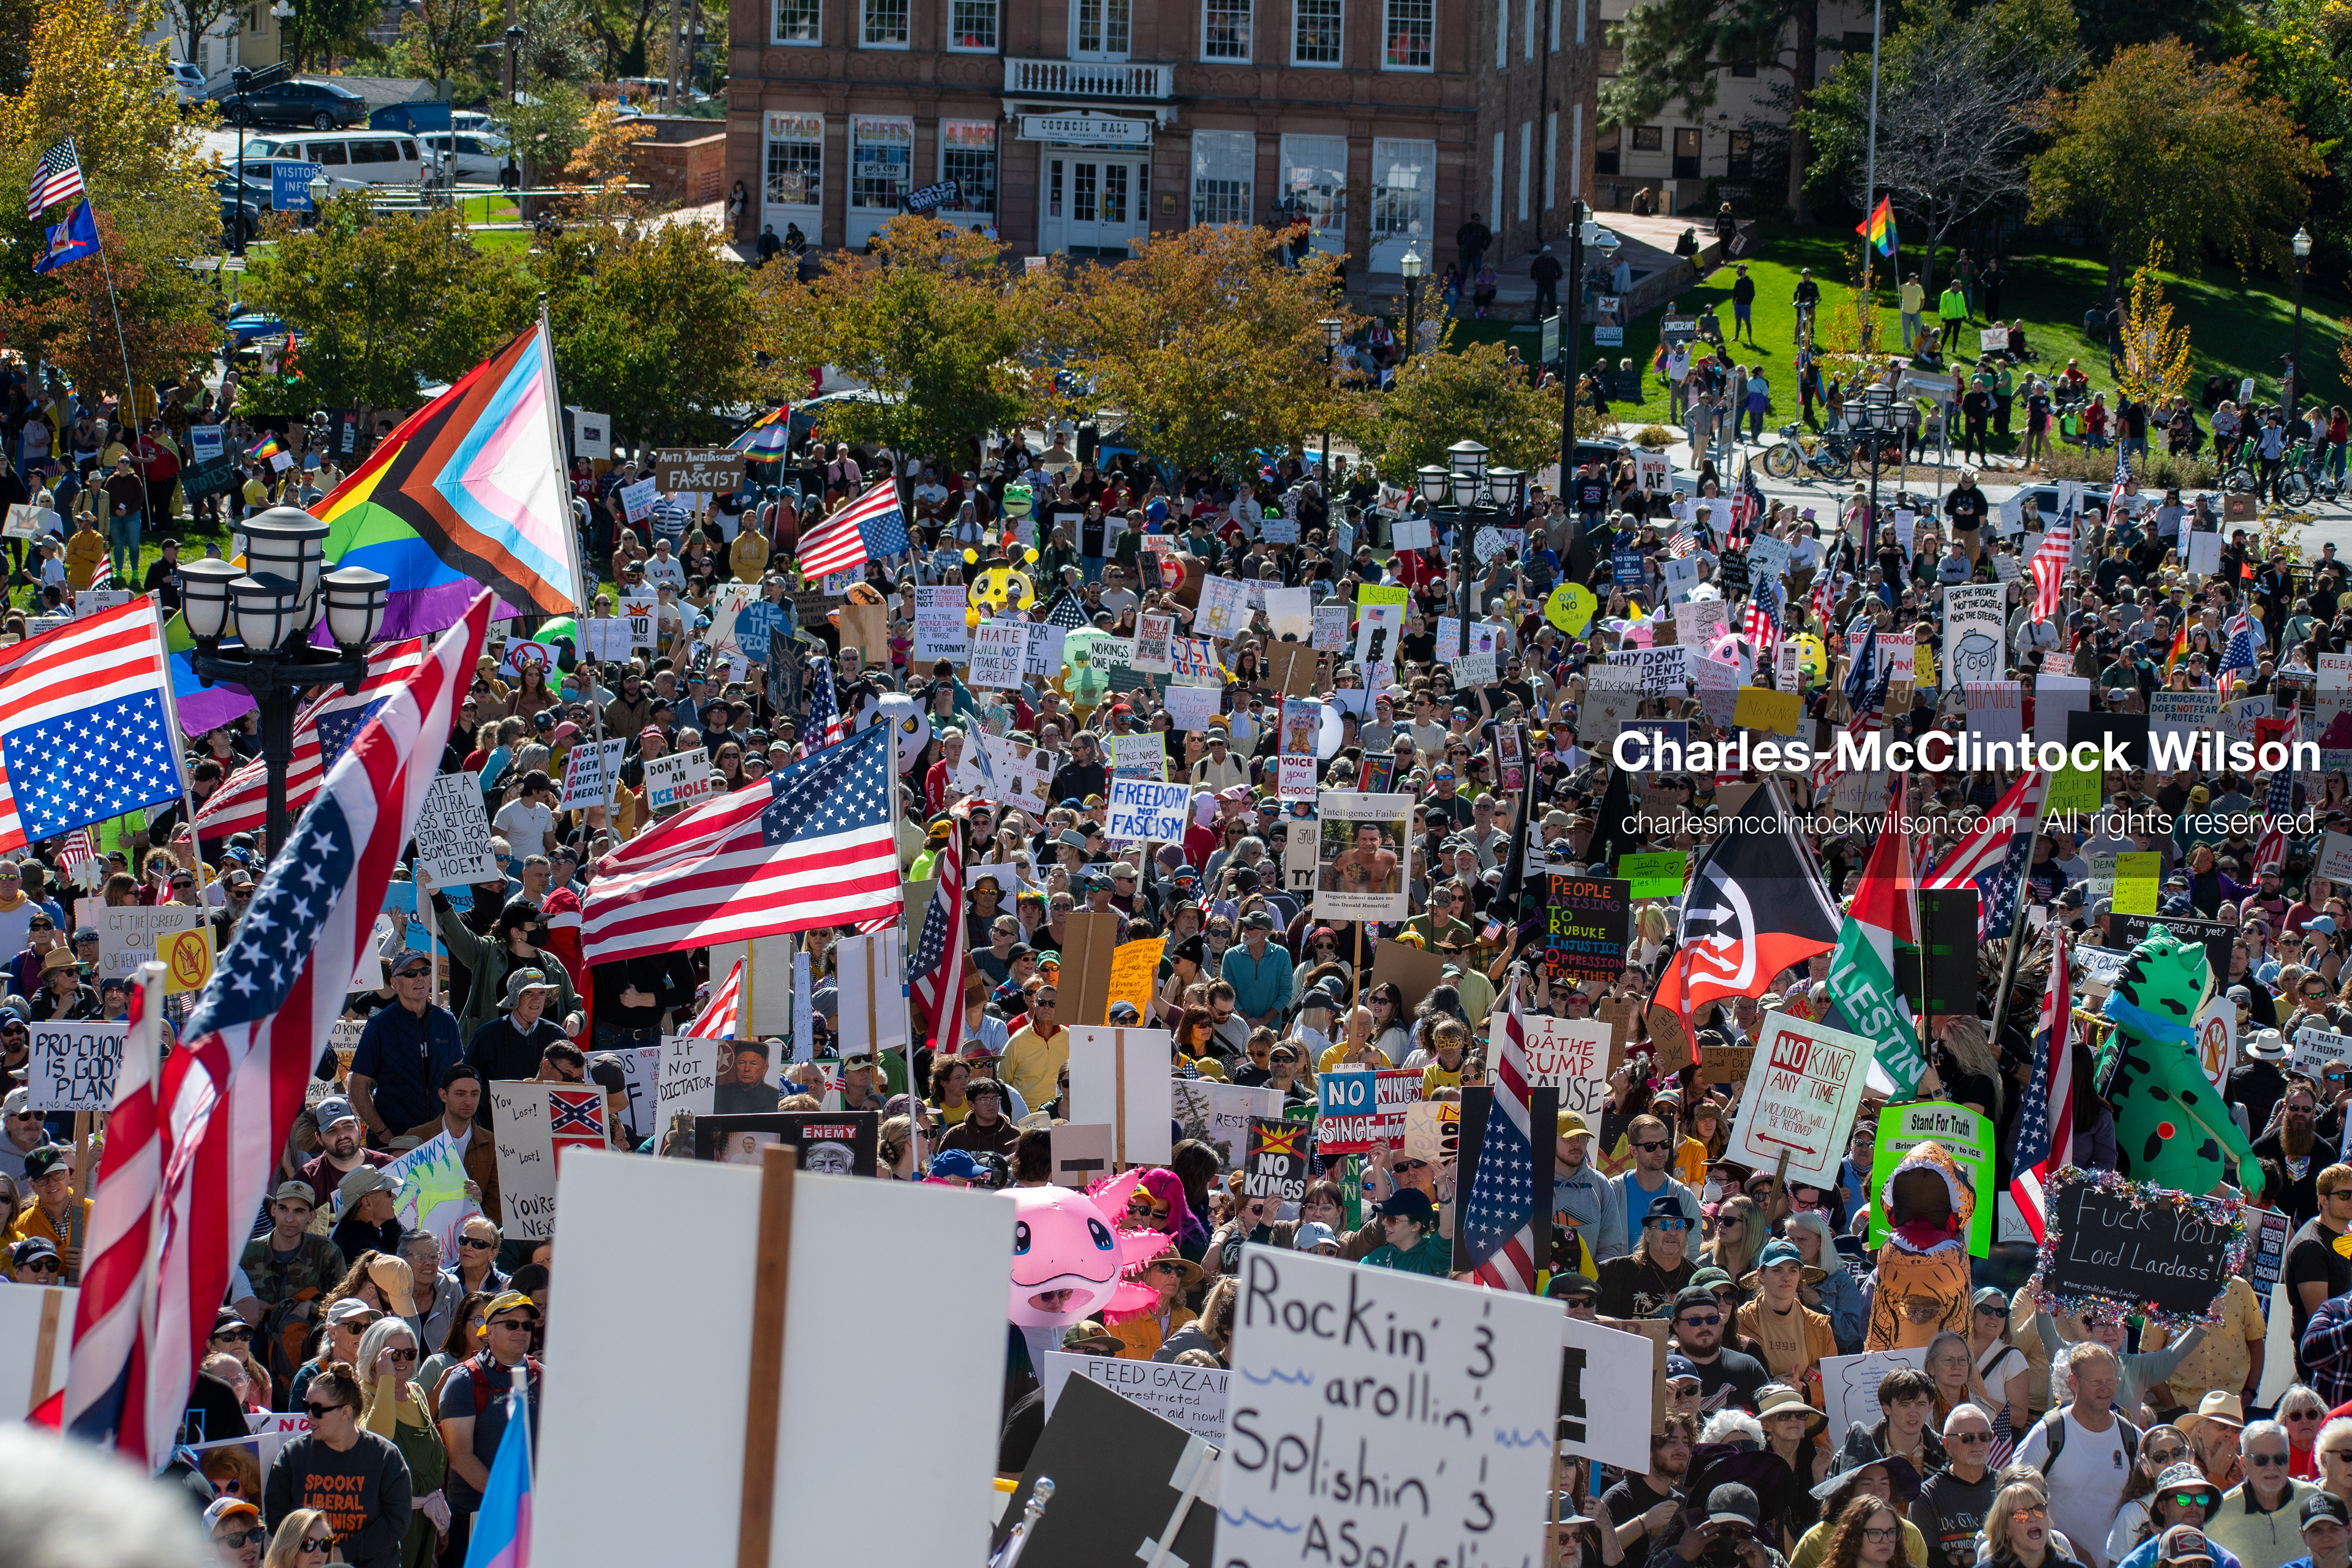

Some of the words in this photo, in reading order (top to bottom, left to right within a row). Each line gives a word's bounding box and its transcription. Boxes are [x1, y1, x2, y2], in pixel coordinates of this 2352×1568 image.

[771, 119, 820, 137] UTAH
[858, 123, 910, 141] GIFTS
[962, 126, 995, 146] INFO
[1042, 121, 1090, 132] COUNCIL
[1102, 123, 1128, 133] HALL
[276, 167, 318, 178] VISITOR
[285, 182, 309, 192] INFO
[659, 451, 682, 462] ANTI
[1645, 472, 1665, 489] AF
[1949, 591, 1961, 602] FOR
[1961, 589, 1973, 598] THE
[1975, 588, 1998, 598] PEOPLE
[1954, 601, 1967, 611] NOT
[1967, 600, 1979, 609] THE
[1980, 599, 2003, 611] CASTLE
[1142, 618, 1162, 630] ONLY
[1163, 621, 1168, 632] A
[1950, 612, 1964, 622] NOR
[1977, 611, 2002, 626] STEEPLE
[981, 630, 1020, 643] HATE
[1142, 630, 1167, 641] FASCIST
[926, 644, 966, 653] TYRANNY
[974, 645, 998, 655] WILL
[1001, 646, 1022, 657] NOT
[974, 657, 1000, 668] MAKE
[1593, 666, 1618, 677] WHAT
[1624, 667, 1632, 677] A
[978, 671, 1014, 684] GREAT
[1587, 678, 1643, 697] FAUX-KING
[1967, 682, 2016, 710] ORANGE
[1589, 694, 1629, 707] NIGHTMARE
[2156, 693, 2215, 705] DEMOCRACY
[2176, 704, 2193, 713] NOT
[2165, 714, 2206, 725] PROTEST,
[650, 757, 682, 776] DON'T
[692, 752, 705, 765] BE
[1282, 757, 1313, 767] VOICE
[672, 771, 686, 783] AN
[1285, 771, 1311, 784] your
[652, 778, 709, 805] ICEHOLE
[1114, 782, 1188, 810] FREEDOM
[1280, 786, 1316, 794] CHOICE
[444, 805, 488, 828] BITCH!
[1324, 807, 1373, 819] Intelligence
[1375, 809, 1406, 818] Failure
[418, 829, 457, 846] STAND
[462, 824, 489, 841] FOR
[1111, 813, 1183, 842] FASCISM
[422, 840, 494, 861] SOMETHING
[438, 856, 484, 878] HOE!!
[1551, 875, 1611, 899] PEOPLE
[1547, 894, 1621, 912] ARISING
[1547, 906, 1573, 922] TO
[1550, 919, 1606, 939] RUBUKE
[1545, 934, 1619, 954] INJUSTICE
[1546, 949, 1624, 968] OPPRESSION
[1546, 963, 1616, 983] TOGETHER
[672, 1039, 693, 1056] IF
[2317, 1033, 2344, 1045] HATE
[1774, 1035, 1804, 1069] NO
[1809, 1042, 1850, 1081] KING
[2310, 1044, 2345, 1057] TRUMP
[45, 1058, 64, 1079] IS
[669, 1060, 701, 1076] NOT
[2304, 1055, 2321, 1066] FOR
[54, 1077, 116, 1102] PLAN
[660, 1076, 714, 1101] DICTATOR
[1329, 1080, 1365, 1106] NO
[1374, 1077, 1423, 1104] KINGS
[1770, 1071, 1801, 1093] ANY
[1811, 1080, 1839, 1104] TIME
[64, 1101, 99, 1111] KINGS
[491, 1094, 511, 1110] You
[512, 1103, 537, 1121] Lost!
[1764, 1101, 1804, 1122] VIOLATORS
[1811, 1114, 1827, 1130] WILL
[1910, 1112, 1934, 1132] Stand
[1936, 1114, 1949, 1133] For
[1950, 1116, 1970, 1137] Truth
[803, 1127, 856, 1139] ENEMY
[1321, 1116, 1376, 1142] SINCE
[1384, 1115, 1406, 1139] 177
[1769, 1115, 1781, 1127] BE
[1783, 1118, 1812, 1137] REMOVED
[391, 1135, 447, 1174] TYRANNY
[499, 1145, 516, 1158] You
[519, 1150, 540, 1165] Lost!
[1258, 1153, 1289, 1176] NO
[1245, 1173, 1305, 1199] KINGS
[2263, 1214, 2286, 1231] FASCISM
[2260, 1227, 2284, 1243] DEFEATED
[2070, 1238, 2121, 1266] Lord
[2263, 1240, 2279, 1254] THEN
[2257, 1253, 2280, 1268] DEFEAT
[2255, 1265, 2278, 1281] FACISM
[1243, 1254, 1439, 1364] Rockin'
[1090, 1362, 1147, 1384] FEED
[1153, 1369, 1227, 1393] GAZA!!
[1232, 1409, 1446, 1517] Splishin'
[305, 1474, 365, 1492] SPOOKY
[303, 1493, 364, 1511] LIBERAL
